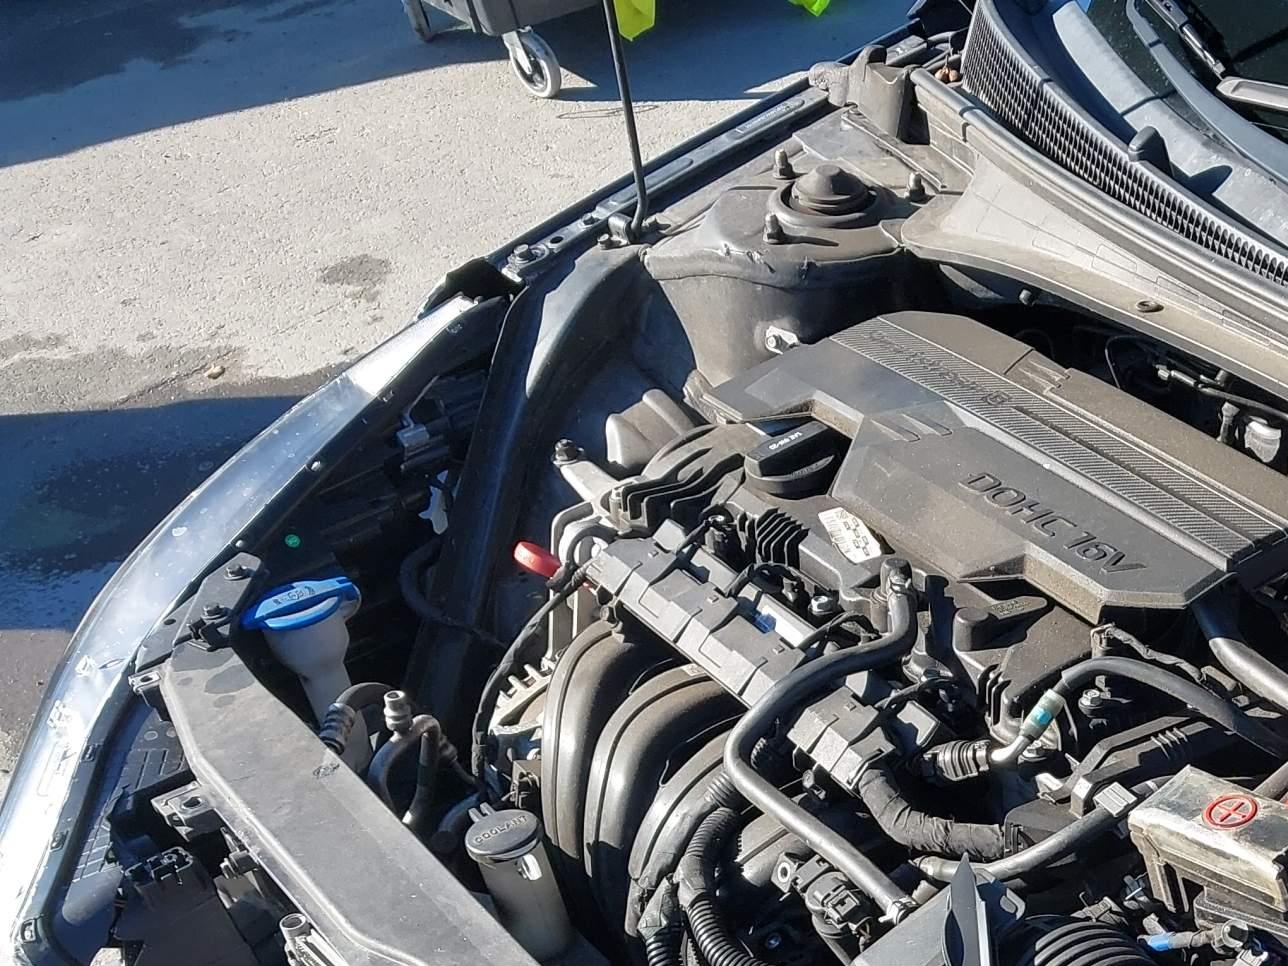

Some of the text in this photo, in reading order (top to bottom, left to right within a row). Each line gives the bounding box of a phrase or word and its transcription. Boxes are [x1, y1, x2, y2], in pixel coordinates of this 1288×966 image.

[958, 472, 1146, 574] DOHC 16V
[474, 815, 527, 844] COOLANT
